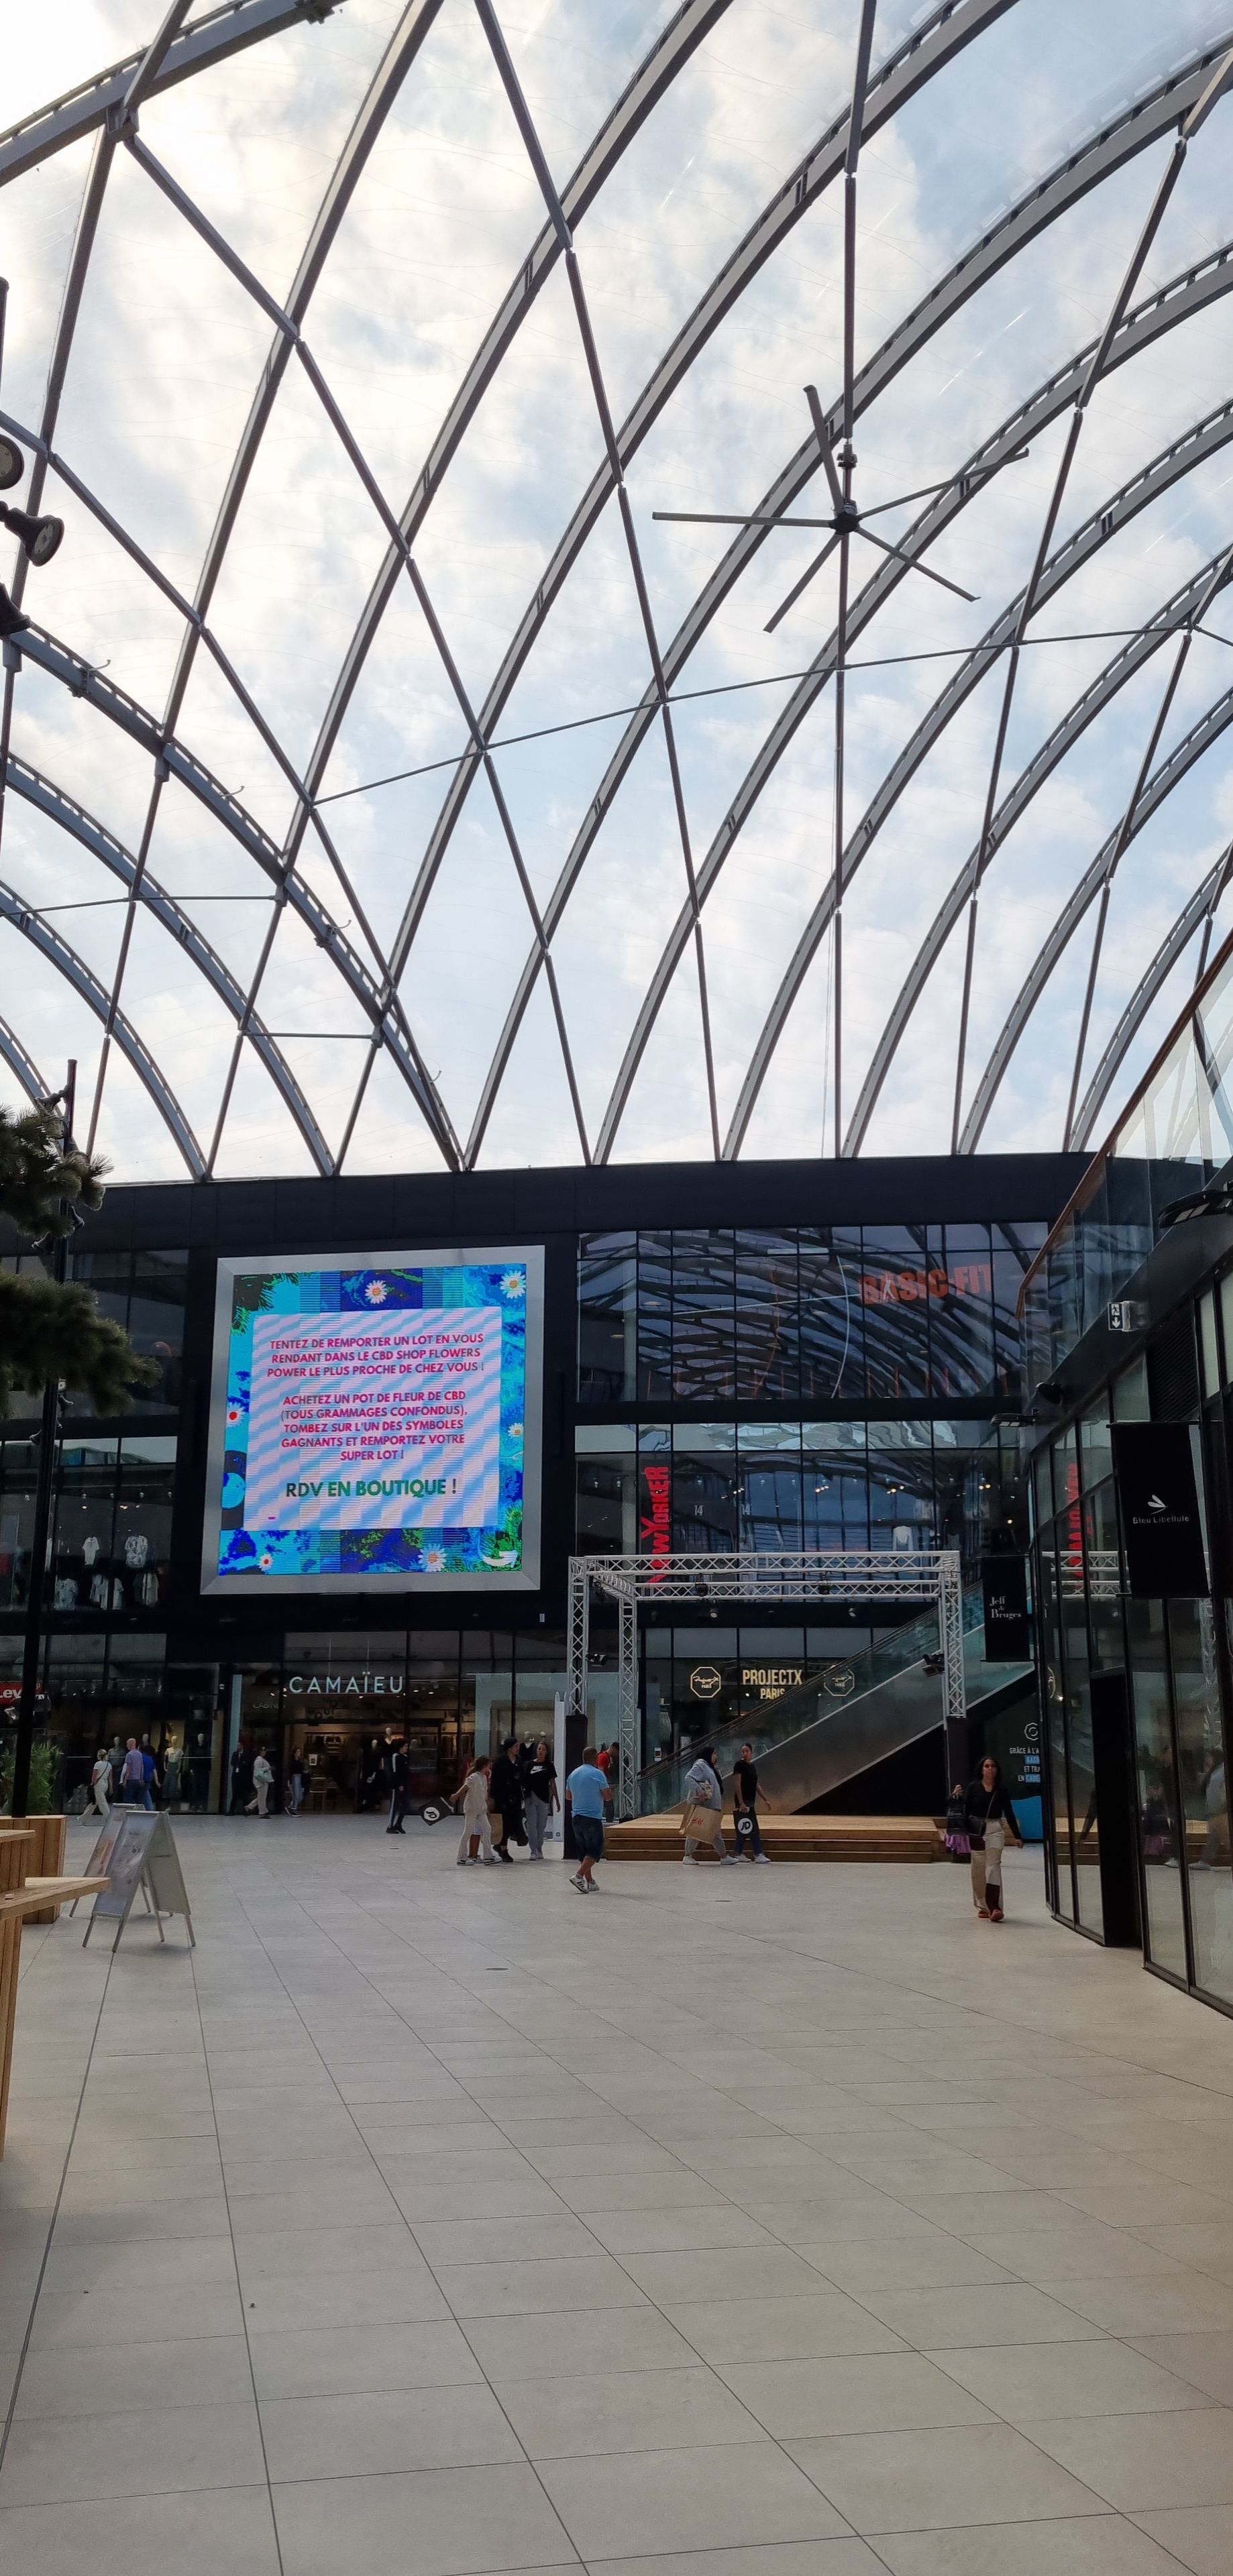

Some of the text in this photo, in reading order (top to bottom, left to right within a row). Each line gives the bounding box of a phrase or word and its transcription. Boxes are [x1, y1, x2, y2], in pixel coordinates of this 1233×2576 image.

[858, 1265, 995, 1305] BASIC-FIT
[270, 1333, 484, 1350] TENTEZ DE REMPORTER UN LOT EN VOUS
[272, 1348, 481, 1363] RENDANT DANS LE CBD SHOP FLOWERS
[267, 1368, 307, 1377] POWER
[309, 1367, 321, 1377] LE
[323, 1366, 350, 1376] PLUS
[353, 1364, 396, 1375] PROCHE
[399, 1364, 413, 1374] DE
[415, 1363, 444, 1373] CHEZ
[447, 1362, 478, 1372] VOUS
[283, 1391, 466, 1405] ACHETEZ UN POT DE FLEUR DE CBD
[280, 1409, 313, 1421] (TOUS
[316, 1407, 387, 1419] GRAMMAGES
[284, 1419, 464, 1434] TOMBEZ SUR L'UN DES SYMBOLES
[281, 1434, 465, 1448] GAGNANTS ET REMPORTEZ VOTRE
[340, 1450, 374, 1461] SUPER
[377, 1450, 398, 1460] LOT
[286, 1478, 458, 1498] RDV EN BOUTIQUE !
[694, 1505, 703, 1516] 14
[1153, 1515, 1190, 1523] Libellule
[989, 1595, 1007, 1607] Jeff
[991, 1608, 1022, 1621] Bruges
[288, 1671, 403, 1694] CAMAÏEU
[742, 1669, 804, 1686] PROJECTX
[760, 1688, 786, 1700] PARIS
